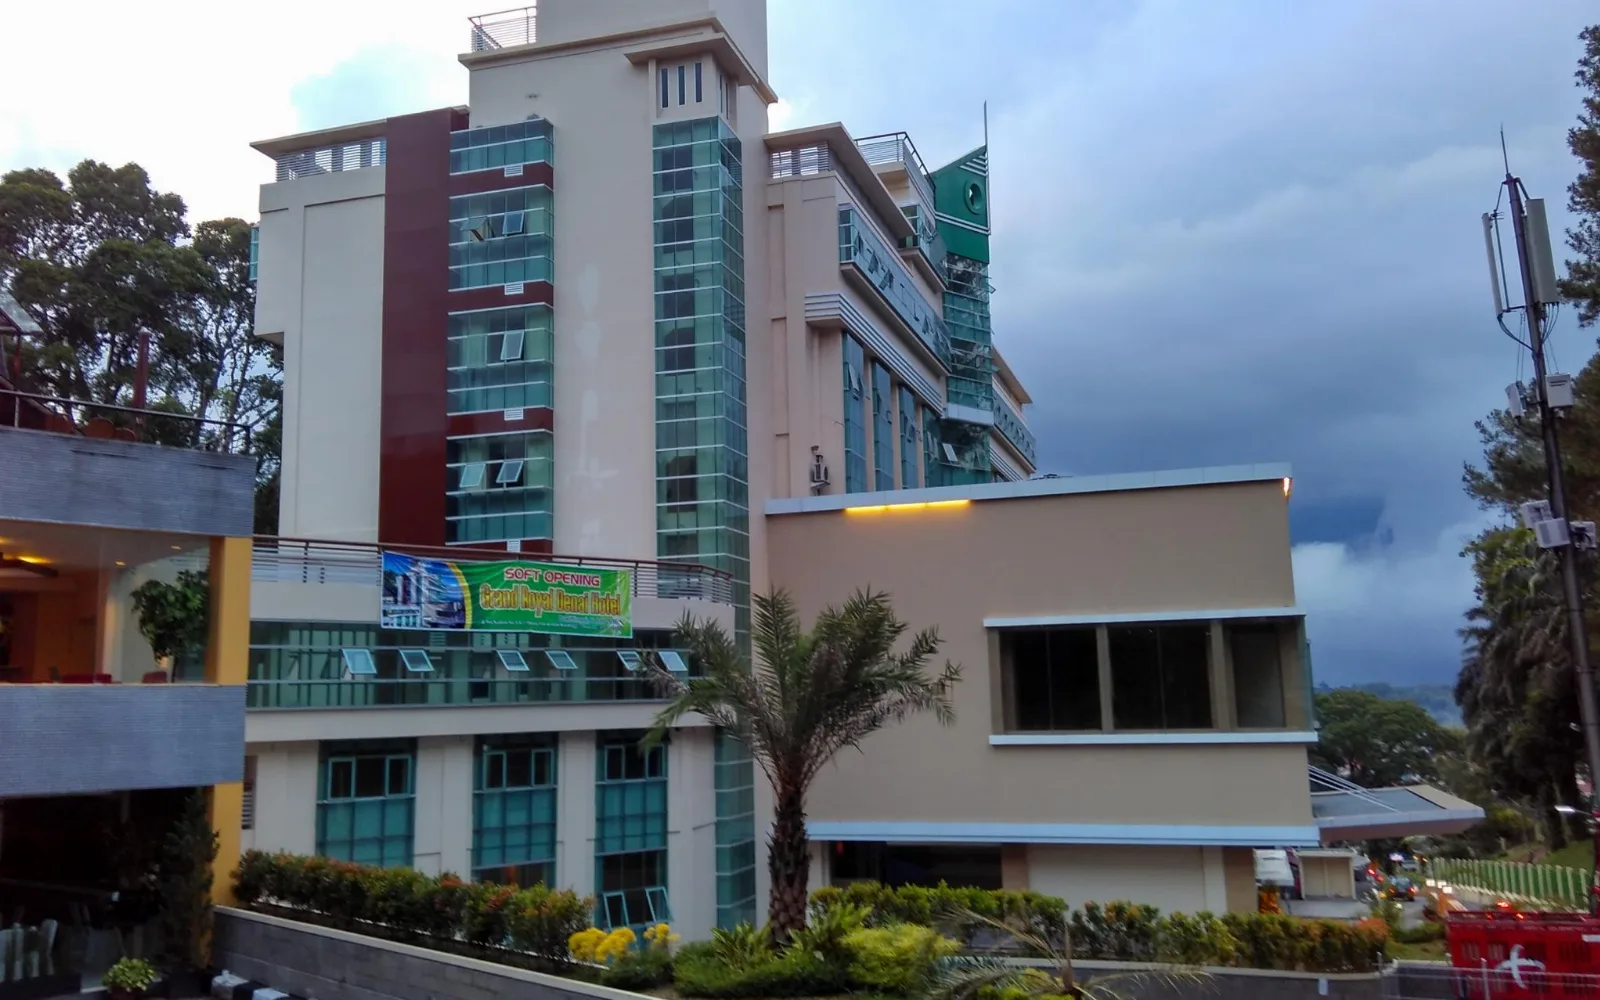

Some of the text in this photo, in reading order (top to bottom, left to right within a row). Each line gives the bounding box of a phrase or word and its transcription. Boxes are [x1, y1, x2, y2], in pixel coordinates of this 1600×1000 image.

[504, 568, 600, 587] SOFT OPENING
[481, 584, 519, 609] Grand
[520, 584, 553, 617] Royal
[591, 591, 621, 615] Hotel
